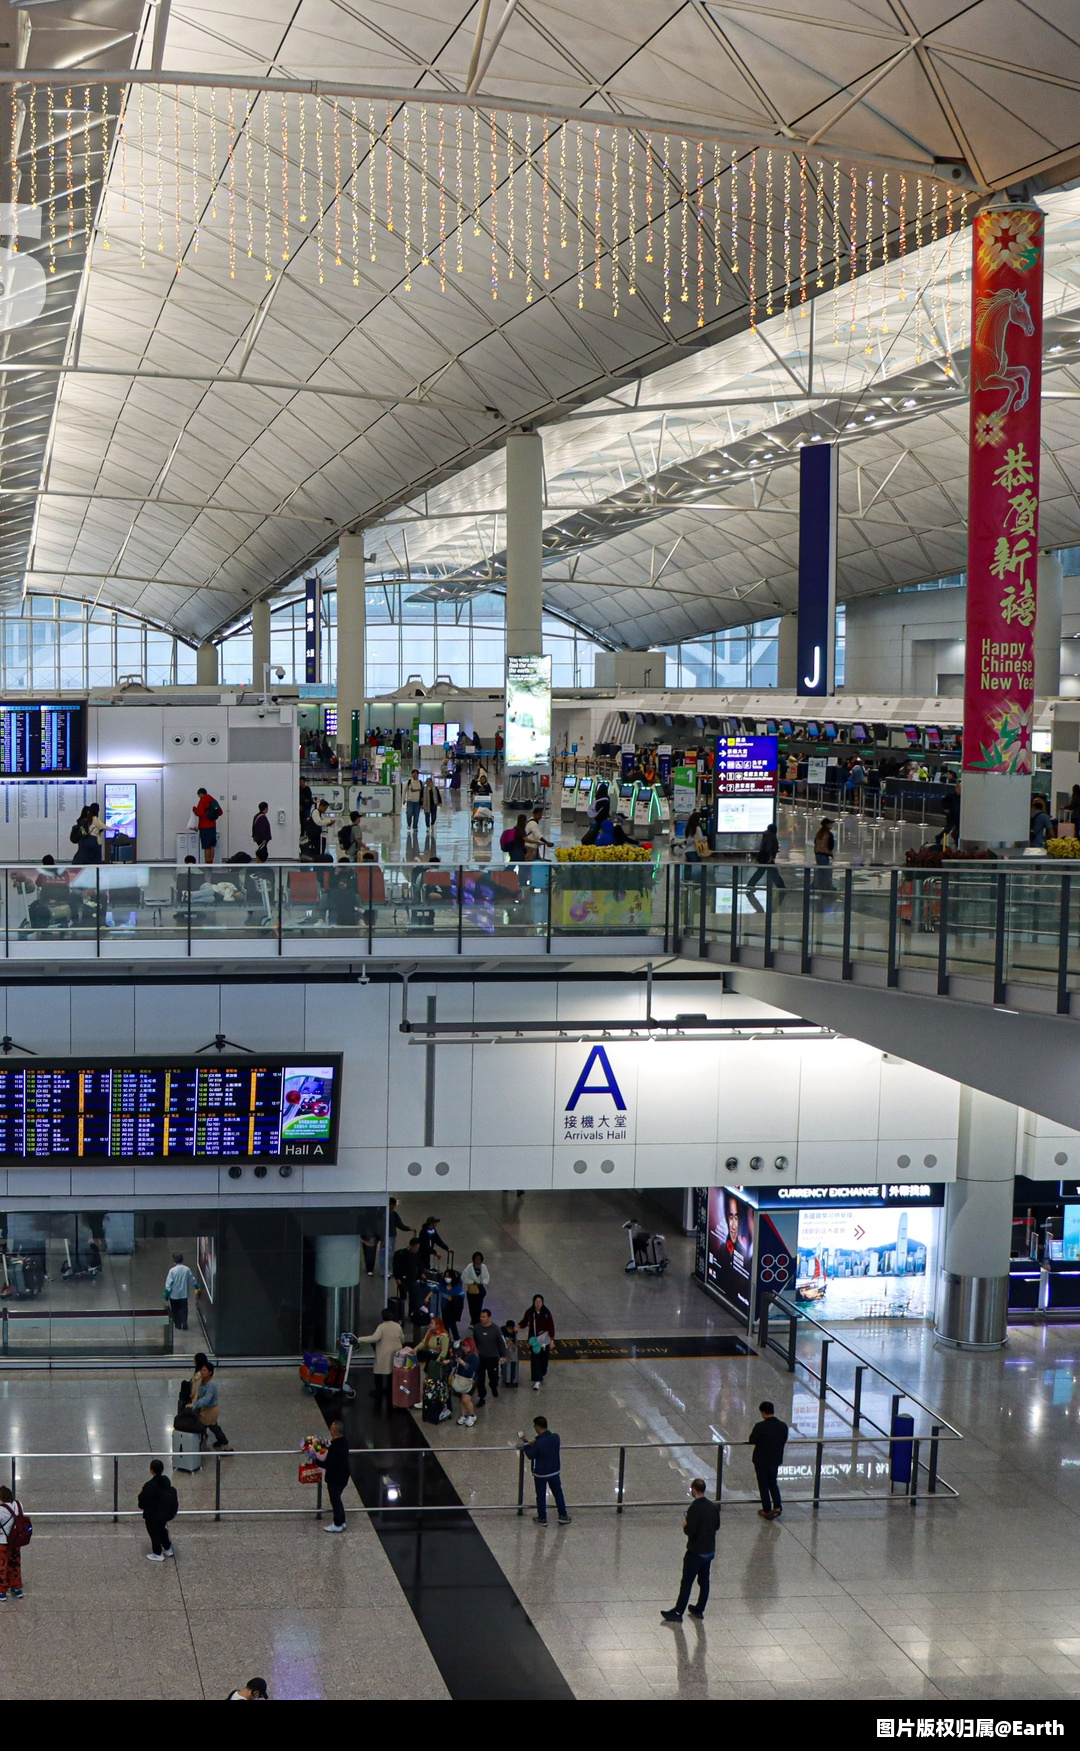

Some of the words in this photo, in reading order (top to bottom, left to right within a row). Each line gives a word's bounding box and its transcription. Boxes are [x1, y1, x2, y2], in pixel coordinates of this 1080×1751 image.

[989, 442, 1038, 626] 恭賀新禧
[982, 638, 1026, 659] Happy
[804, 646, 820, 688] J
[981, 656, 1033, 672] Chinese
[981, 673, 1012, 690] New
[1017, 673, 1034, 690] Yea
[393, 753, 398, 763] 2
[686, 770, 693, 783] 1
[565, 1045, 627, 1111] A
[564, 1115, 627, 1129] 接機大堂
[564, 1131, 603, 1140] Arrivals
[607, 1130, 626, 1140] Hall
[286, 1145, 309, 1155] Hall
[313, 1145, 323, 1155] A
[778, 1188, 828, 1198] CURRENCY
[829, 1187, 878, 1198] EXCHANGE
